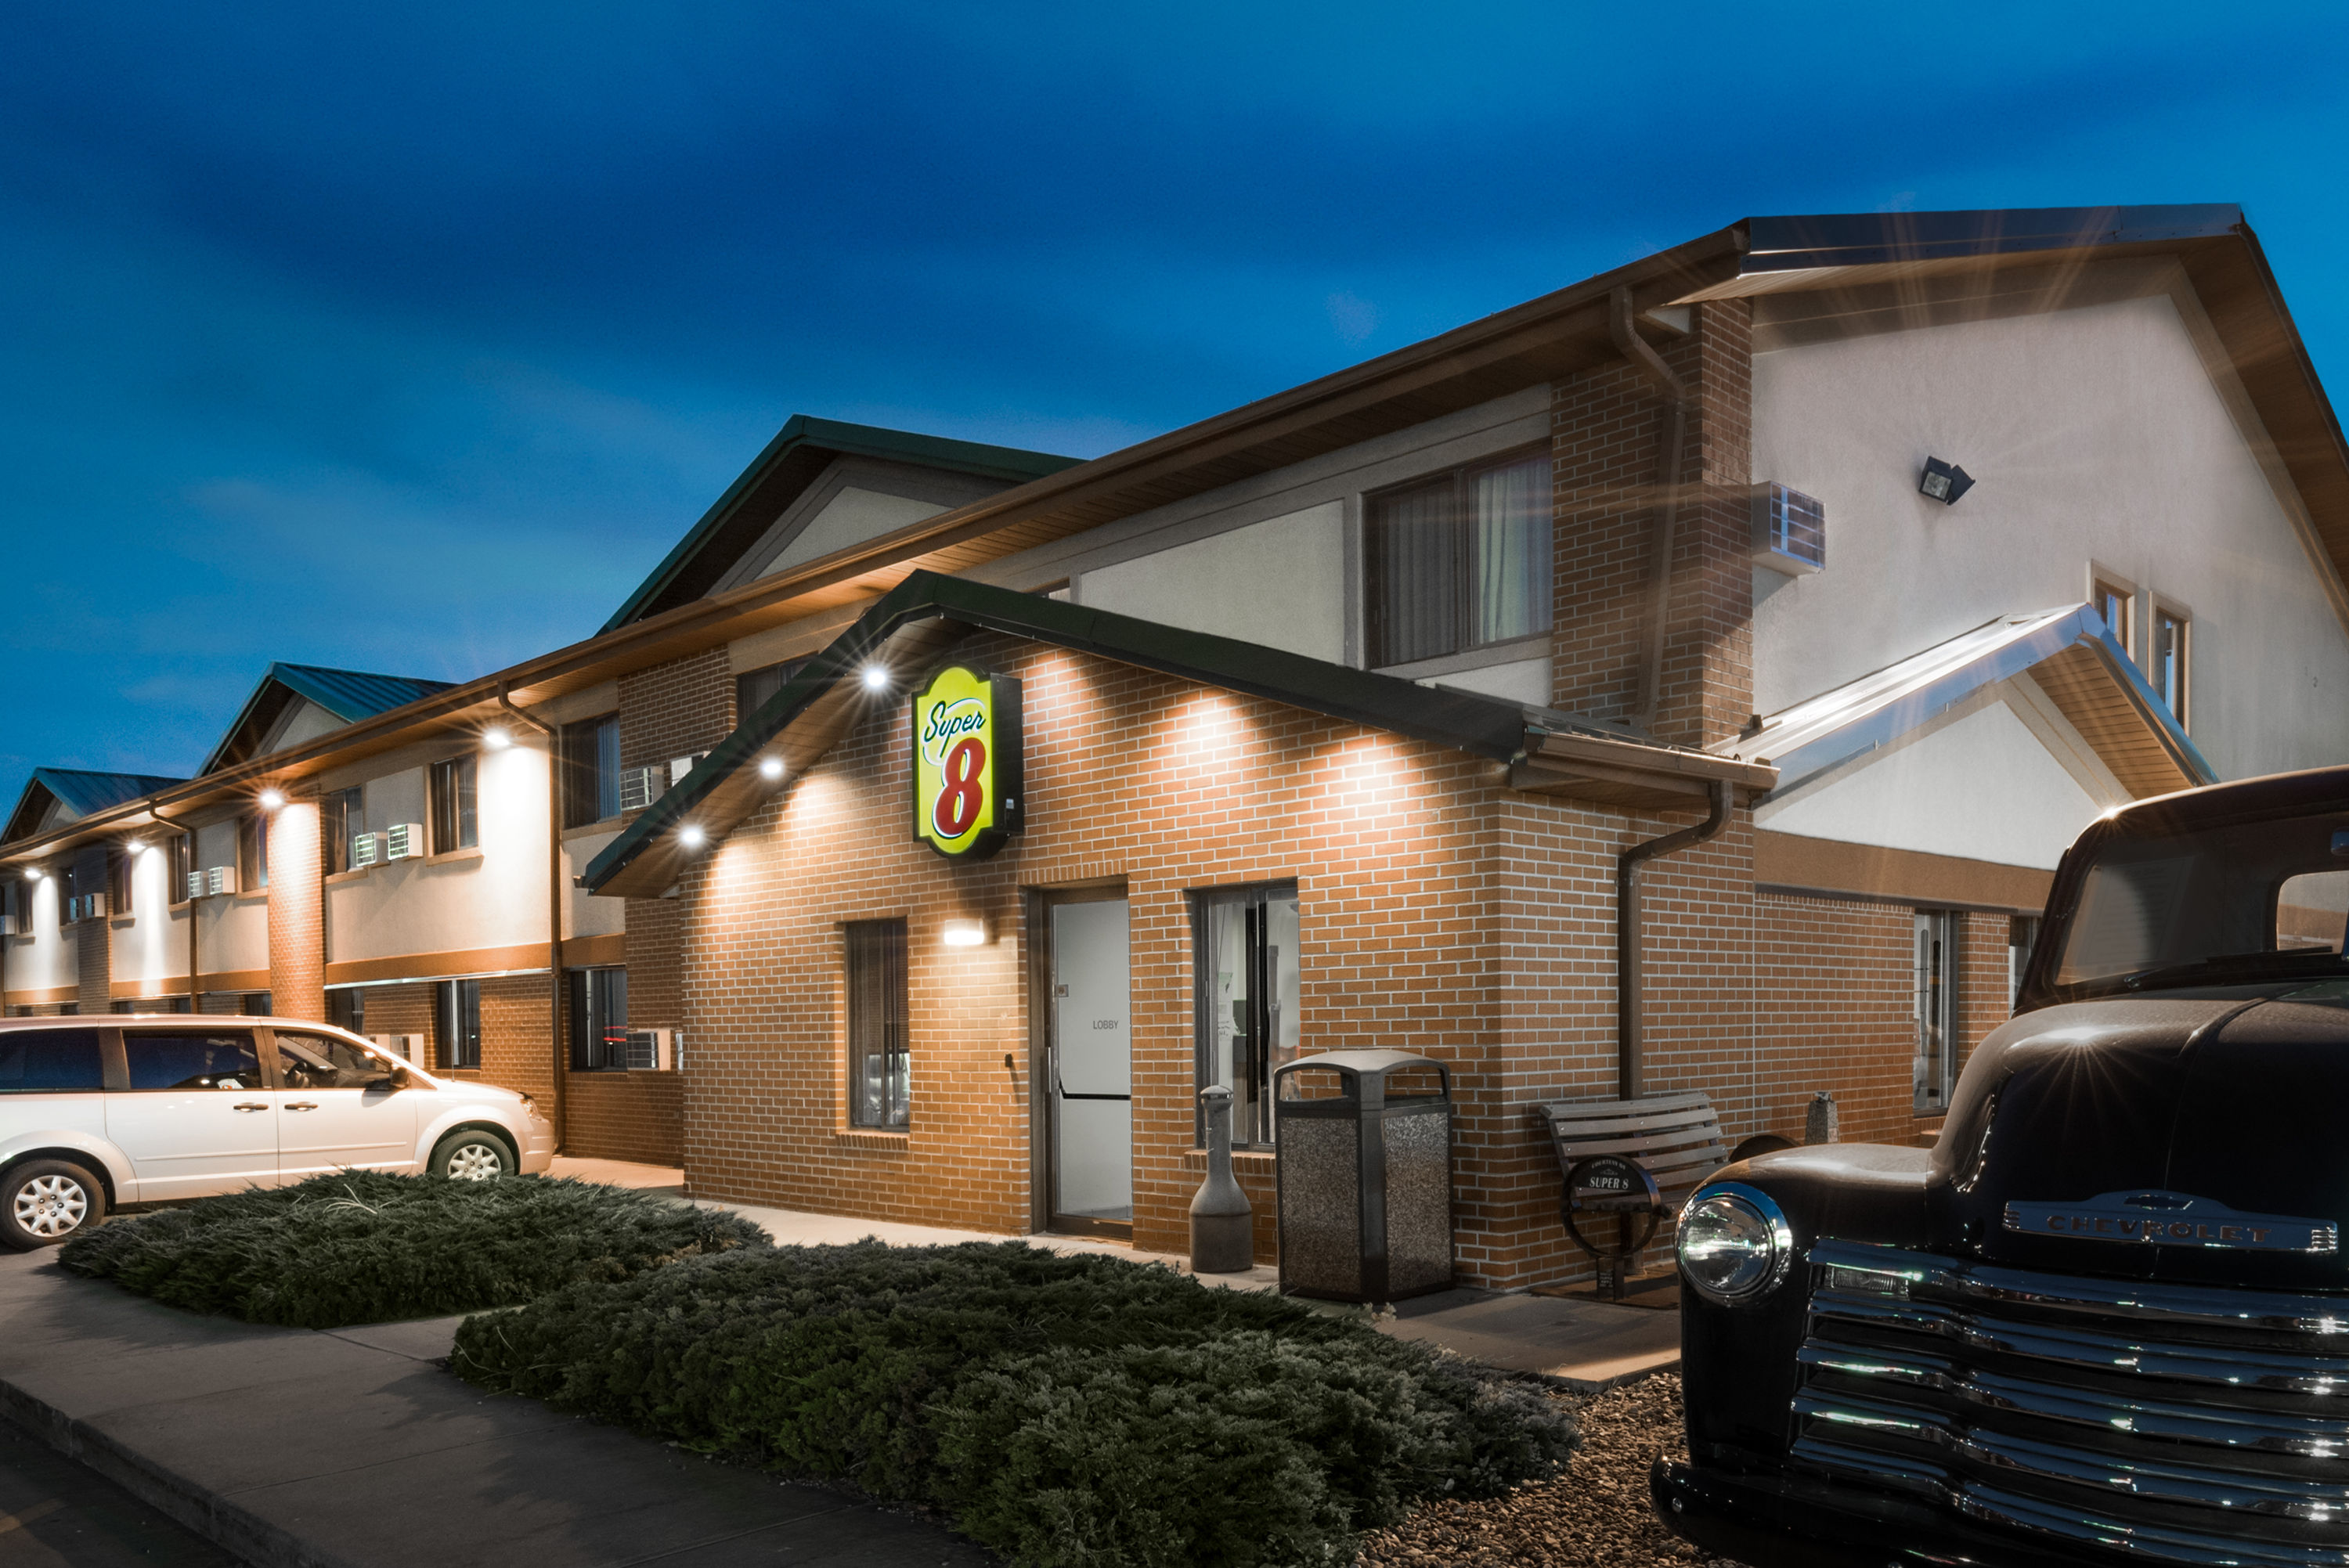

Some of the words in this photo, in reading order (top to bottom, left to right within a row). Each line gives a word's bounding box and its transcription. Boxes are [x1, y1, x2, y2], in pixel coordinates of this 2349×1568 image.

[923, 700, 987, 759] Super
[932, 737, 986, 838] 8
[1093, 1020, 1118, 1029] LOBBY
[1589, 1177, 1620, 1189] SUPER
[1622, 1178, 1629, 1190] 8
[2046, 1215, 2272, 1243] CHEVROLET
